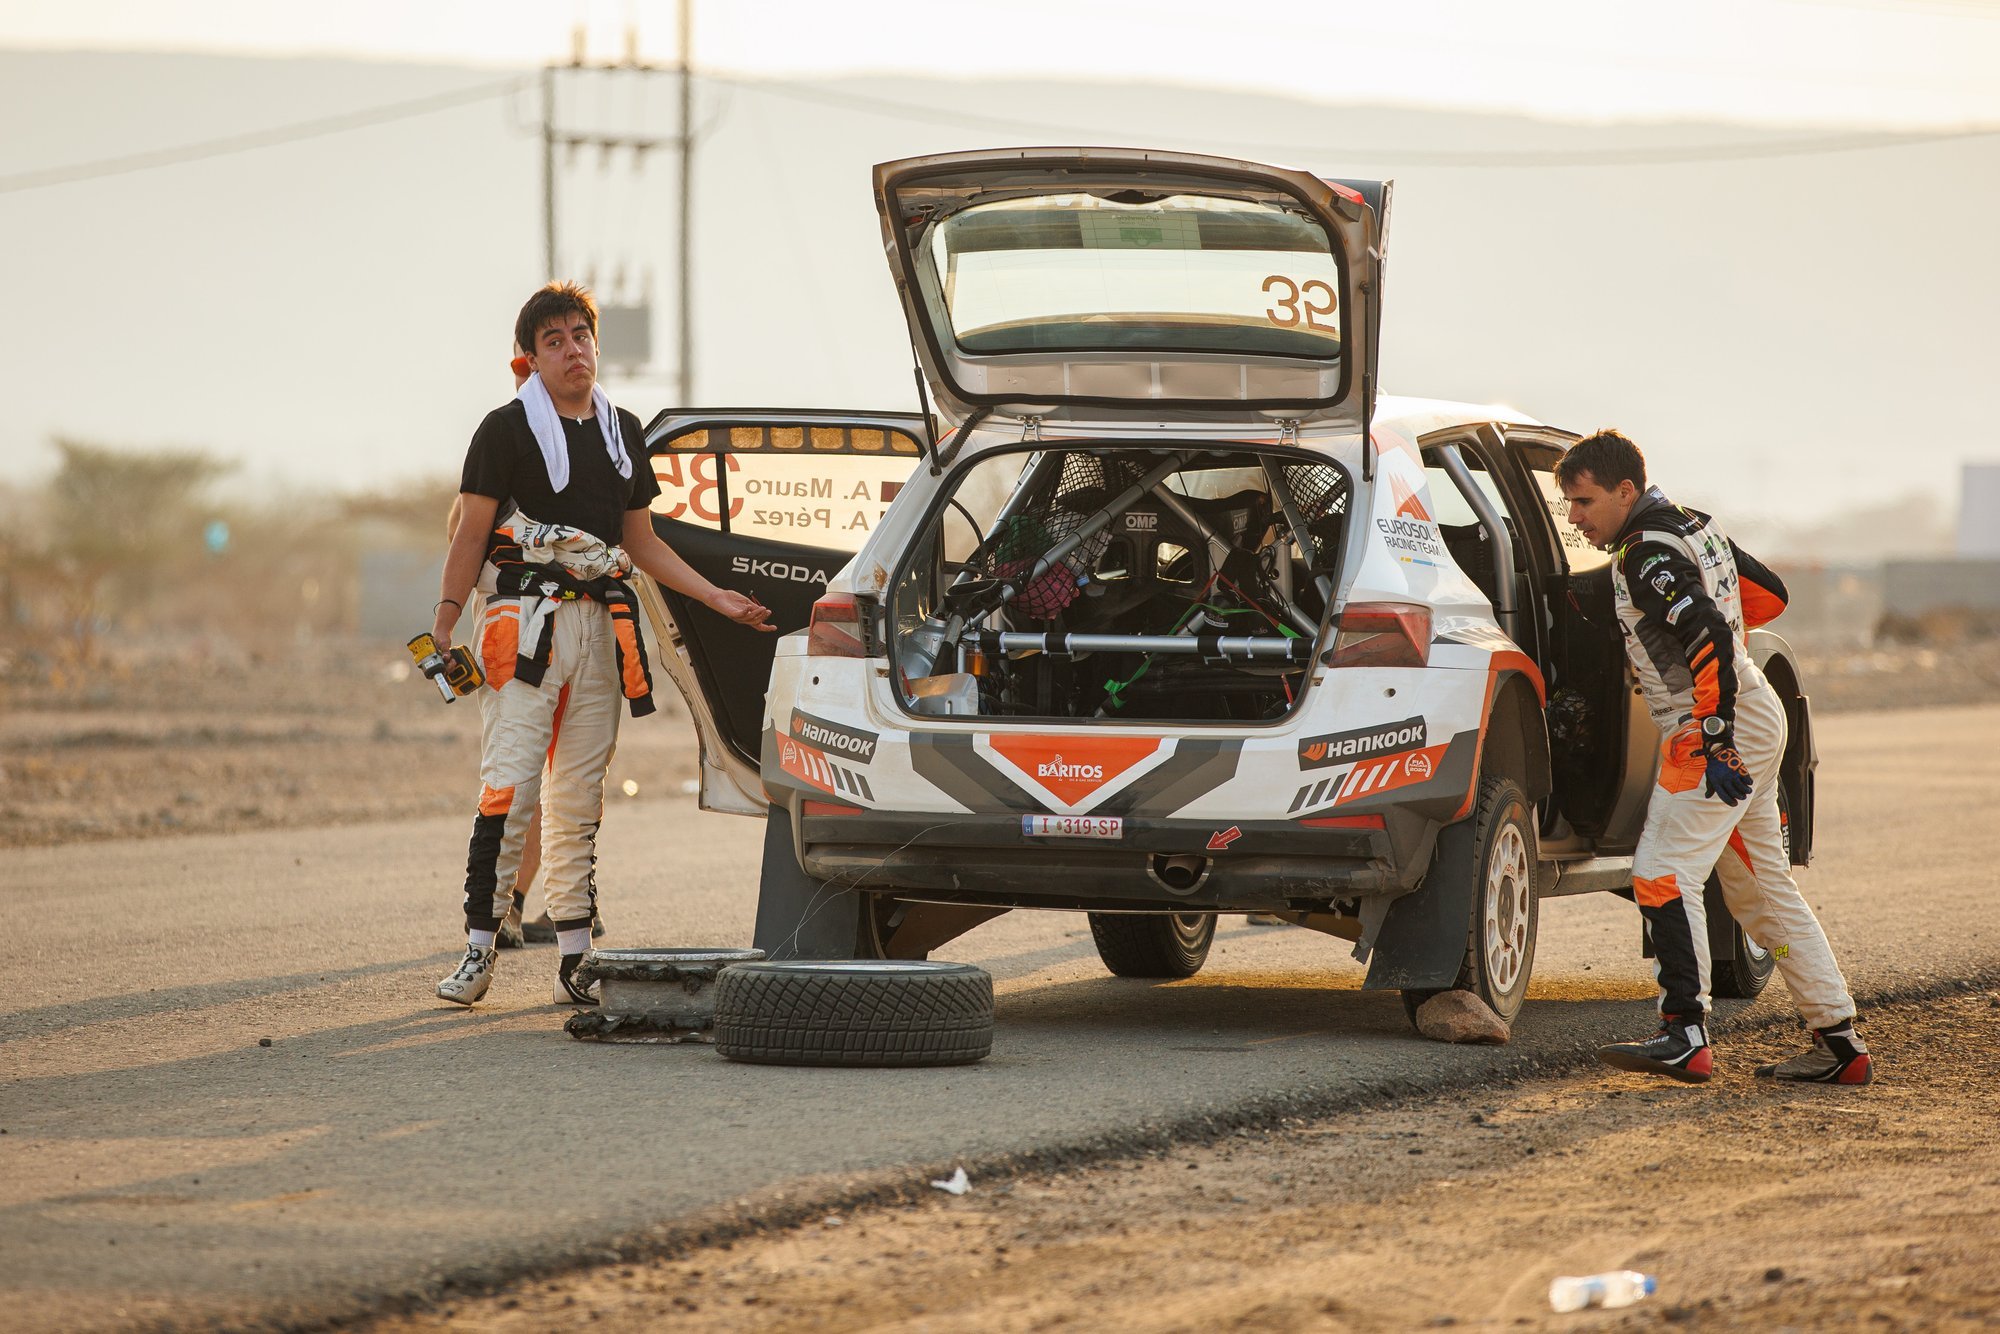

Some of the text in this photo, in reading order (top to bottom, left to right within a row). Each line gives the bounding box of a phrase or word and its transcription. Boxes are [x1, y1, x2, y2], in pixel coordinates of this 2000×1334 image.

[1125, 516, 1158, 529] OMP
[1233, 515, 1248, 530] OMP
[1376, 519, 1436, 542] EUROSOL
[1384, 536, 1442, 557] RACING TEAM
[1038, 763, 1103, 779] BARITOS
[1063, 819, 1119, 836] 319-SP
